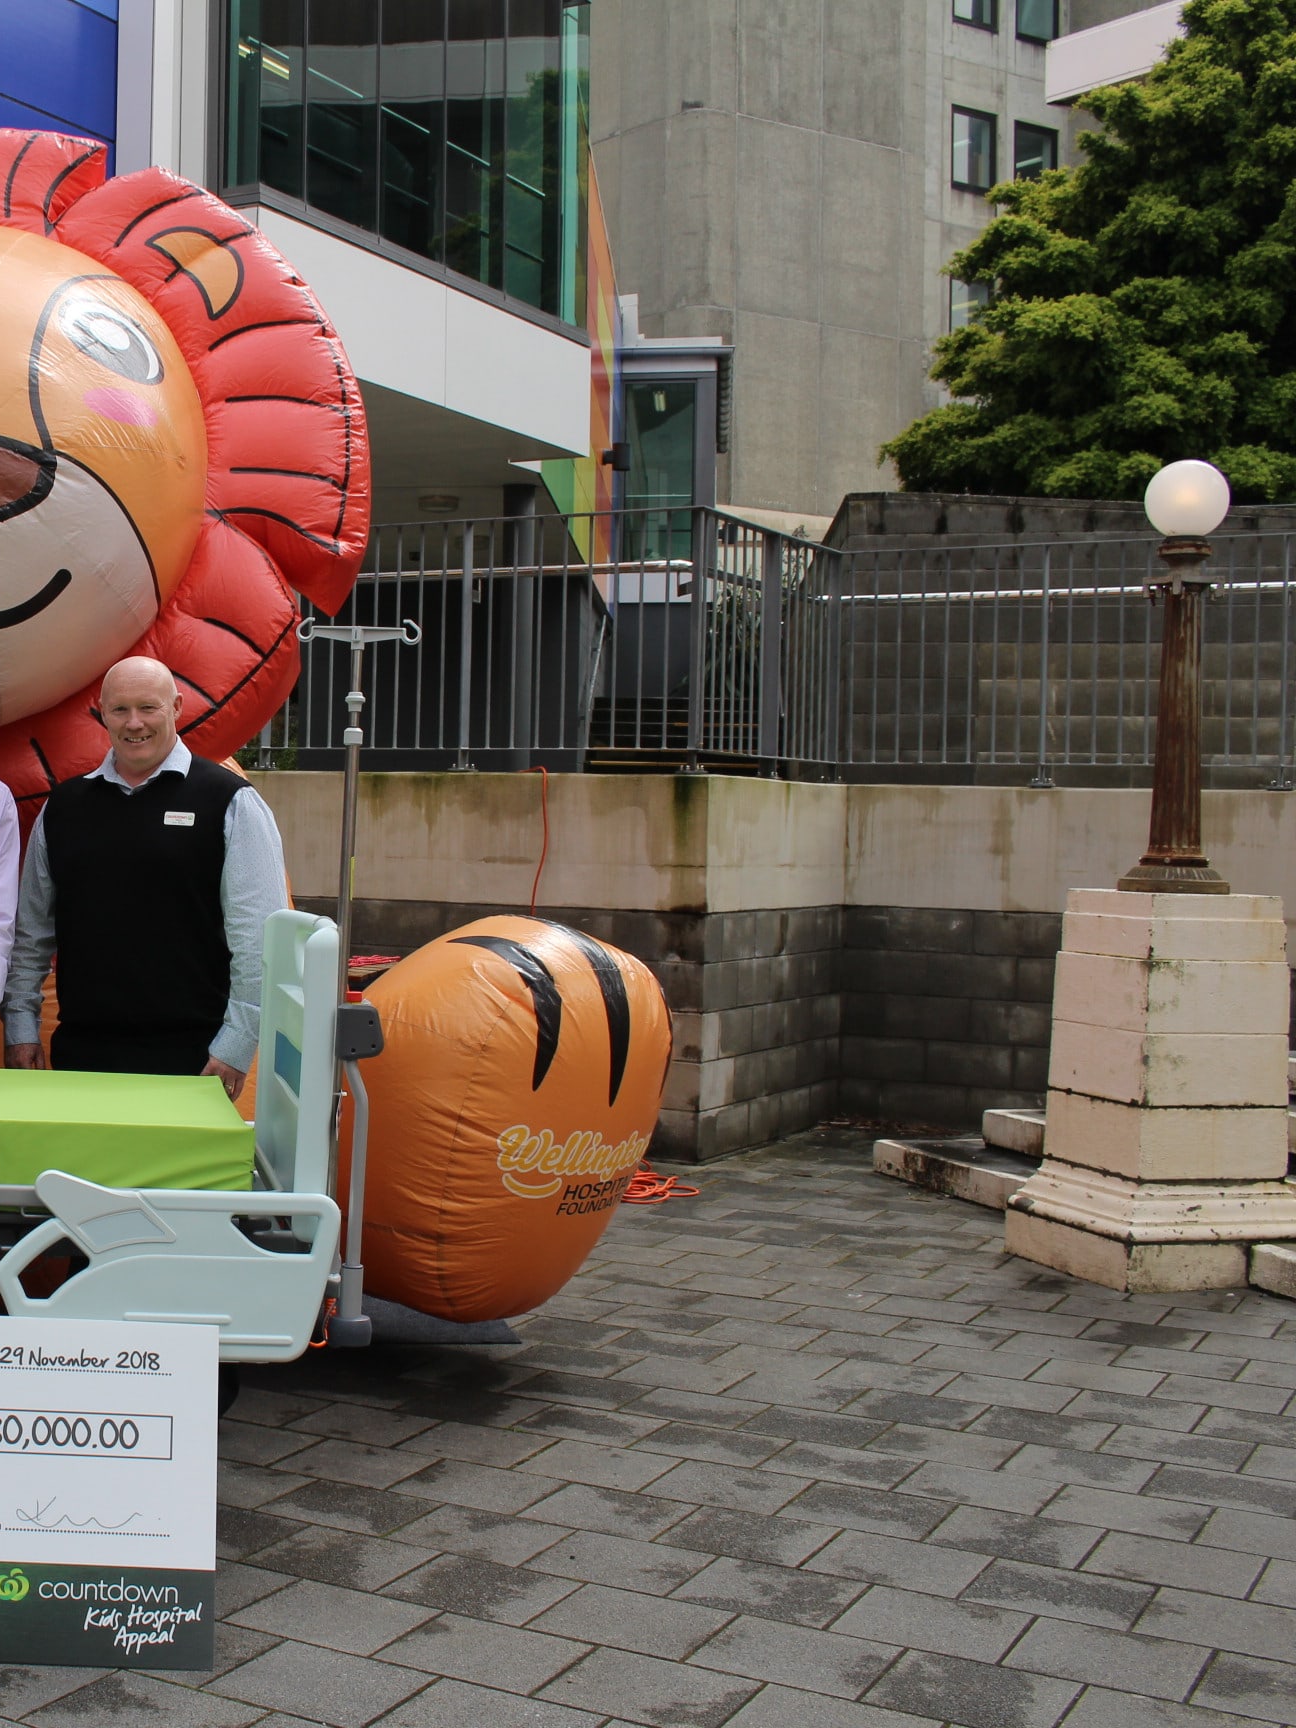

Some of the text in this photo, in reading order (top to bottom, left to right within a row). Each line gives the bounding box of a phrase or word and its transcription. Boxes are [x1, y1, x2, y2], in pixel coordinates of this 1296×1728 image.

[563, 1176, 628, 1201] HOSPITA
[556, 1193, 621, 1216] FOUNDAT
[29, 1346, 110, 1370] November
[115, 1350, 161, 1371] 2018
[38, 1577, 179, 1604] countdown
[84, 1602, 202, 1630] Kids Hospital
[113, 1624, 176, 1655] Appeal
